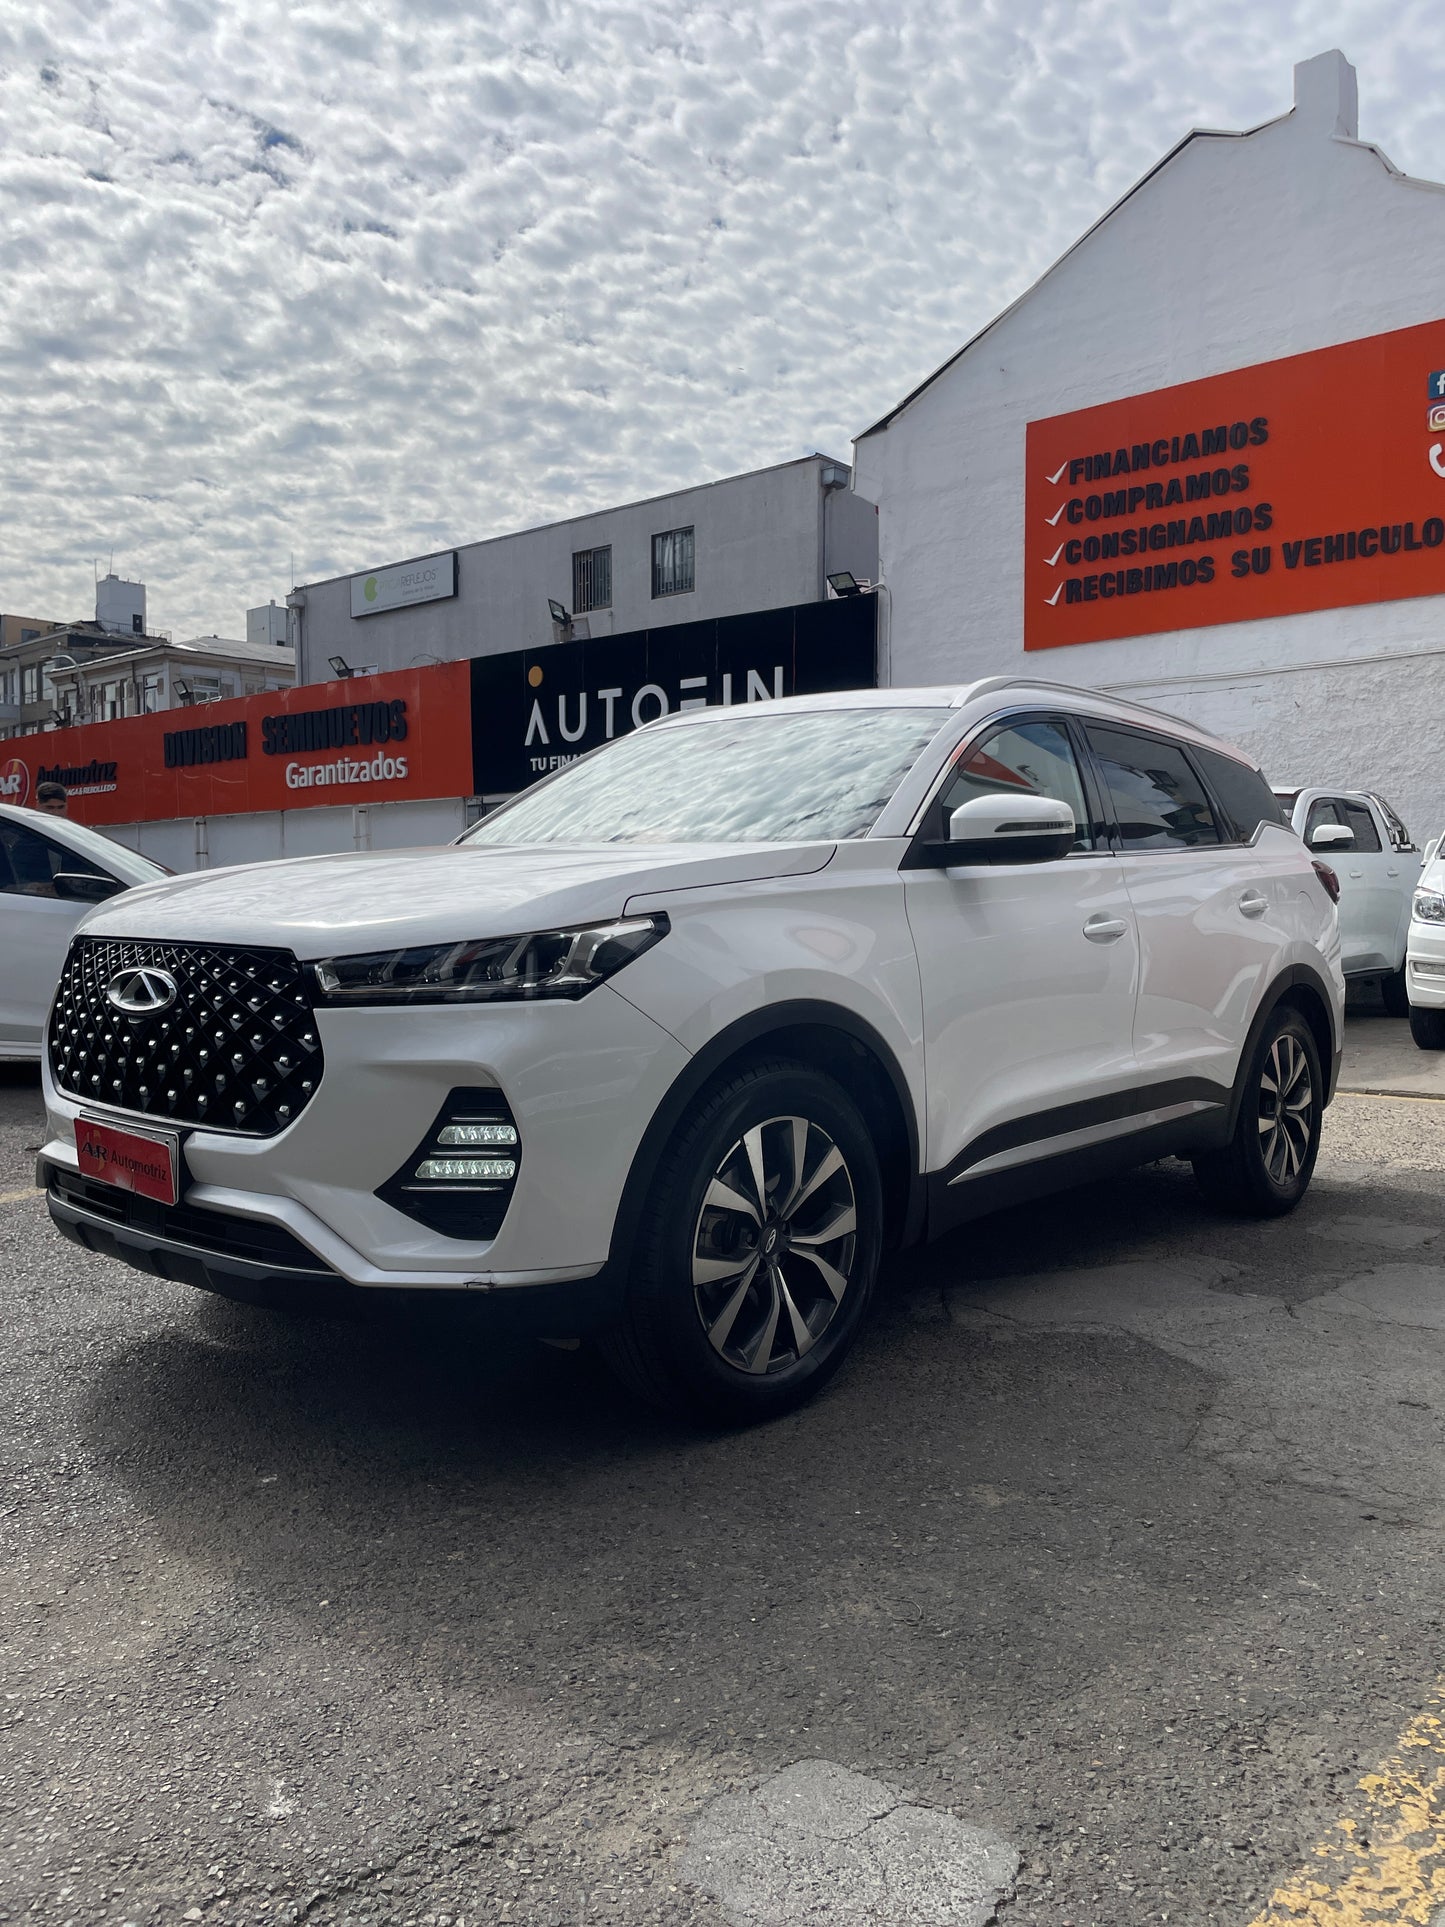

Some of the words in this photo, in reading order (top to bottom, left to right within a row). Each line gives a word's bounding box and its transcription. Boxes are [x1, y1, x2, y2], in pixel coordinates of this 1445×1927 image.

[1069, 417, 1269, 485] FINANCIAMOS
[1066, 464, 1250, 524] COMPRAMOS
[1065, 503, 1273, 565] CONSIGNAMOS
[1065, 556, 1215, 604] RECIBIMOS
[1231, 546, 1271, 578] SU
[1282, 517, 1444, 570] VEHICULO
[164, 721, 247, 768] DIVISION
[262, 699, 408, 755] SEMINUEVOS
[530, 757, 547, 771] TU
[286, 751, 408, 789] Garantizados
[111, 1150, 167, 1181] Automotriz
